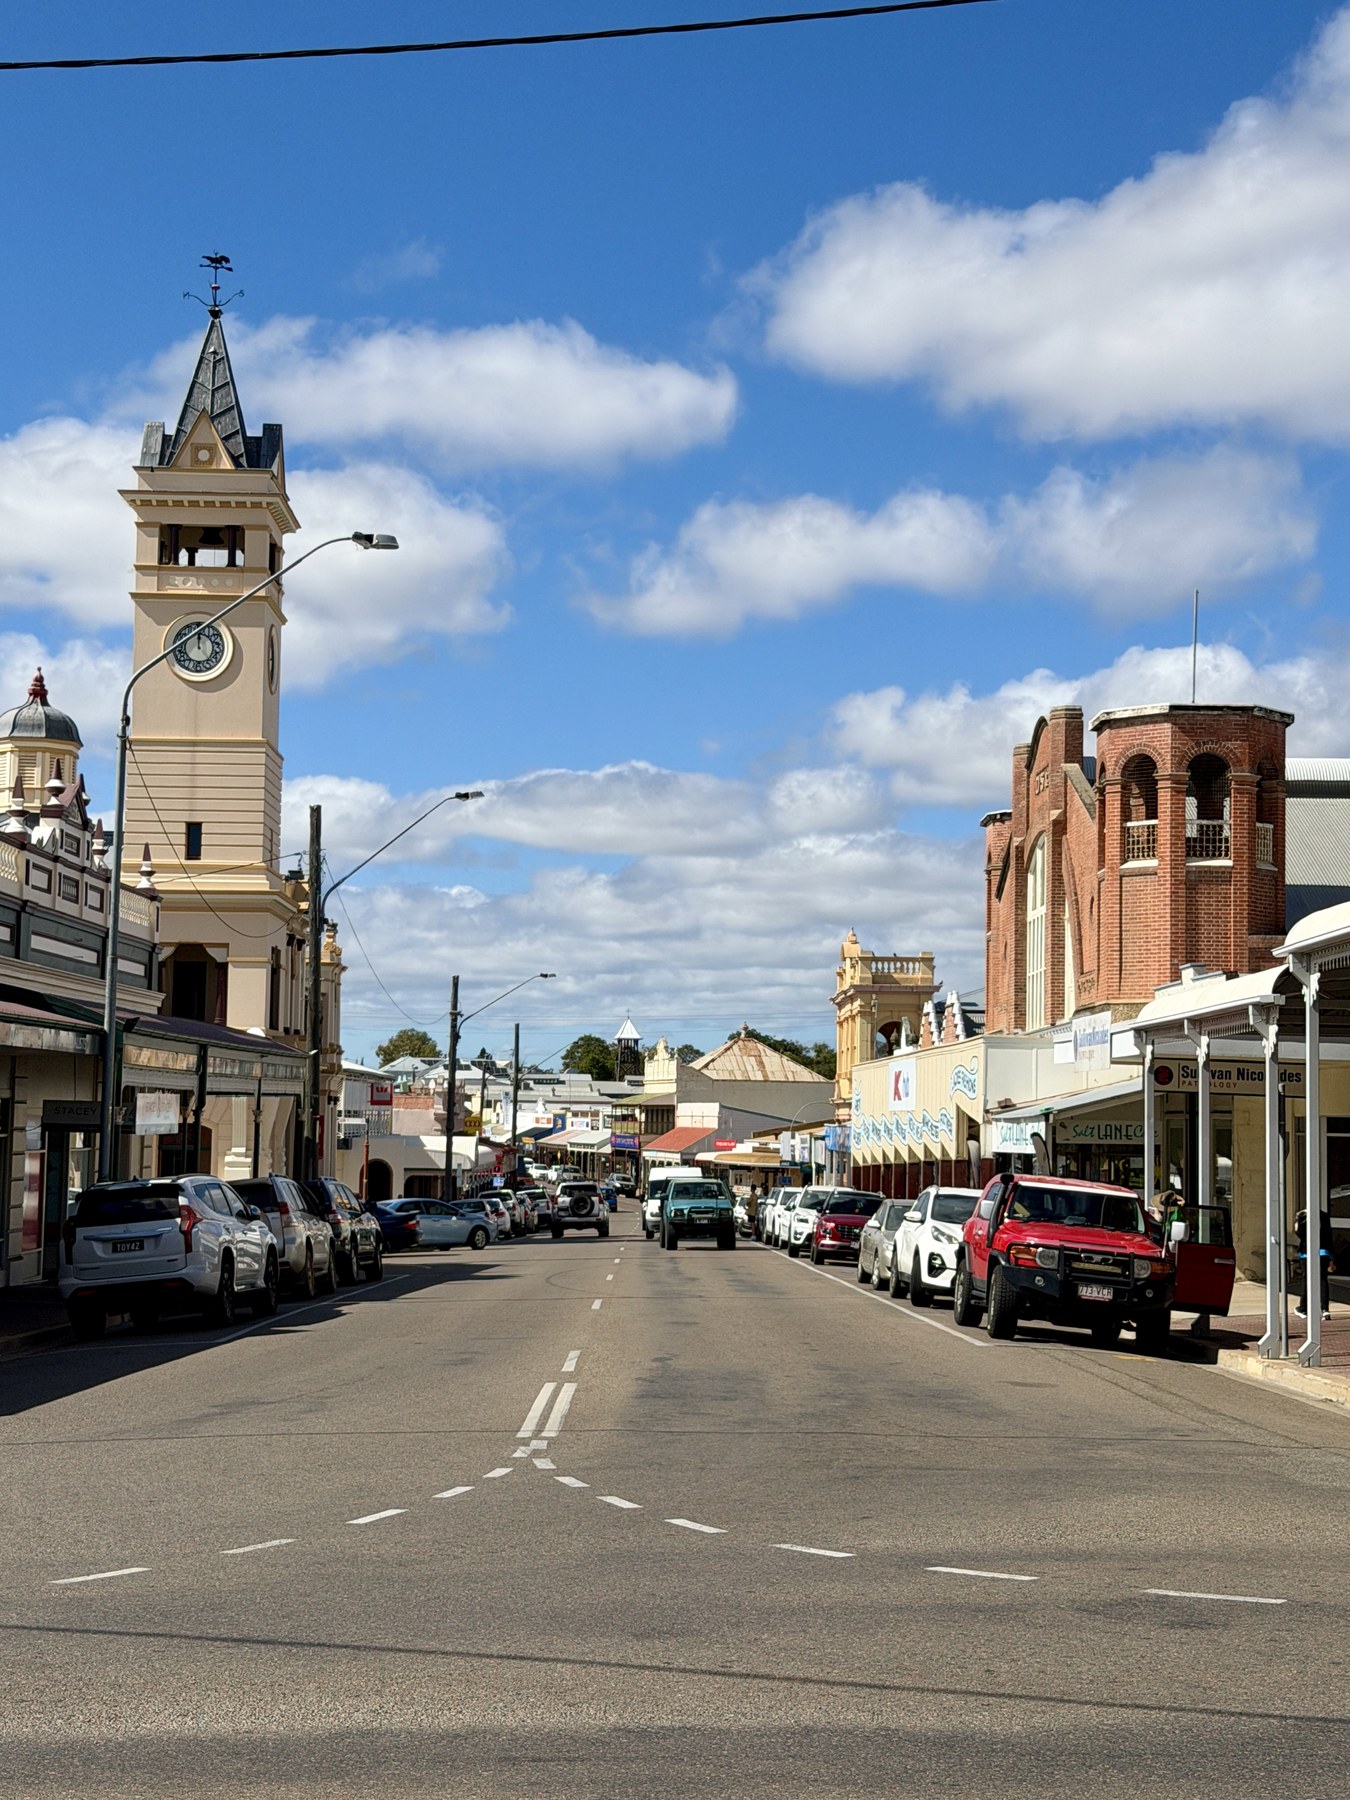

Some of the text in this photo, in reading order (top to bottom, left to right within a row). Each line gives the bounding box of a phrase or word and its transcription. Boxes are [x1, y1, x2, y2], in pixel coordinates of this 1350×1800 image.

[1181, 1065, 1302, 1083] Suvan Nicodes
[54, 1106, 97, 1116] STACEY
[1072, 1124, 1095, 1138] Salt
[1097, 1124, 1132, 1140] LANE
